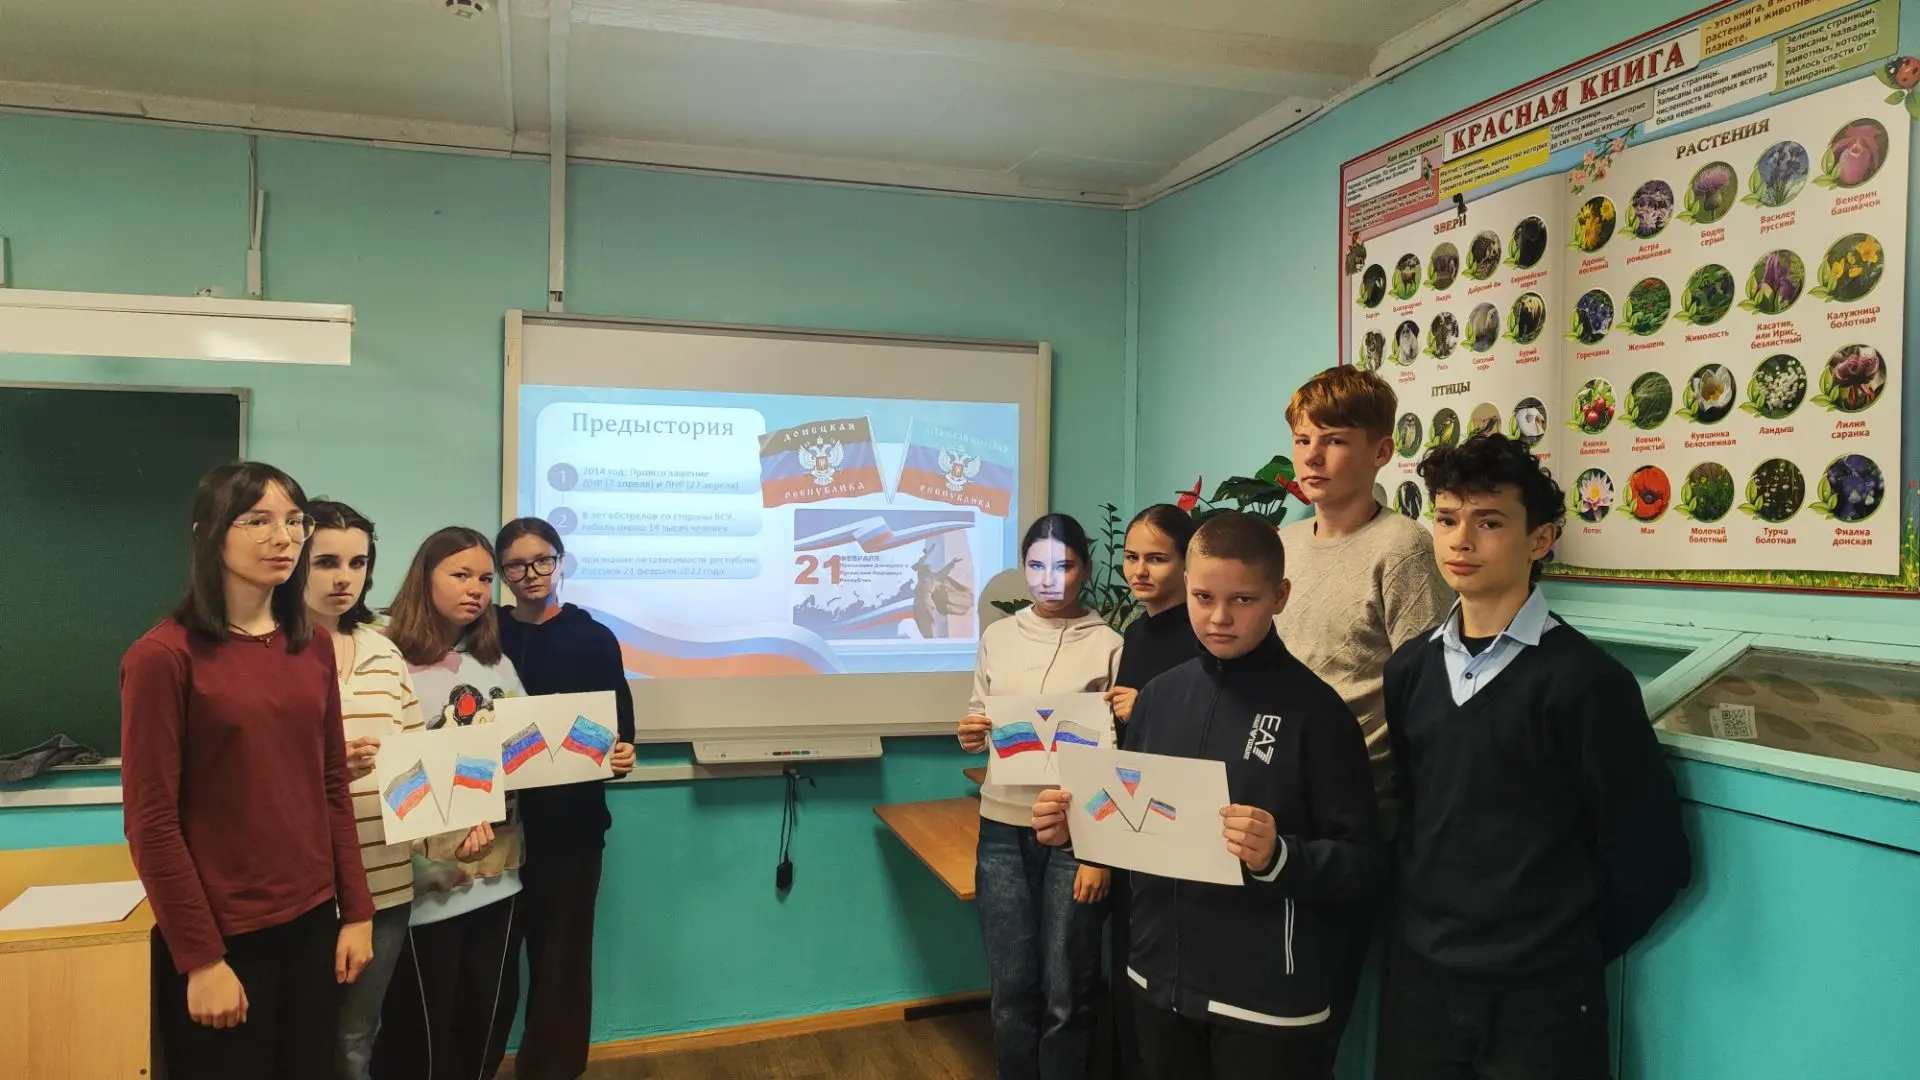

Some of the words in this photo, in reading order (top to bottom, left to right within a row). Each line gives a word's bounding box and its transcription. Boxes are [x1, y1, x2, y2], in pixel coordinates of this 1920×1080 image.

[1714, 17, 1731, 29] это
[1733, 4, 1764, 20] книга,
[1706, 18, 1751, 46] растений
[1786, 26, 1825, 44] Зеленые
[1827, 8, 1875, 29] страницы.
[1786, 35, 1828, 54] Записаны
[1831, 18, 1875, 38] названия
[1705, 34, 1748, 55] планете.
[1786, 45, 1832, 65] животных,
[1836, 29, 1877, 47] которых
[1784, 60, 1820, 77] удалось
[1823, 48, 1854, 64] спасти
[1856, 43, 1867, 52] от
[1657, 84, 1679, 96] Белые
[1682, 70, 1720, 87] страницы.
[1784, 64, 1838, 86] вымирания.
[1657, 89, 1692, 106] Записаны
[1693, 76, 1729, 93] названия
[1731, 61, 1774, 80] животных,
[1452, 87, 1568, 153] КРАСНАЯ
[1580, 42, 1685, 104] КНИГА
[1656, 97, 1702, 115] численность
[1704, 83, 1737, 99] которых
[1740, 73, 1767, 86] всегда
[1656, 114, 1674, 125] была
[1676, 118, 1770, 159] РАСТЕНИЯ
[1835, 190, 1878, 206] Венерин
[1760, 209, 1796, 224] Василек
[1433, 215, 1467, 235] ЗВЕРИ
[1760, 218, 1796, 235] русский
[1638, 243, 1660, 254] Астра
[1700, 235, 1725, 248] серый
[1826, 305, 1881, 321] Калужница
[1756, 320, 1794, 332] Касатик,
[1830, 315, 1877, 329] болотная
[1684, 330, 1729, 343] Жимолость
[1750, 335, 1802, 349] безлистный
[1755, 332, 1767, 340] или
[1769, 328, 1797, 339] Ирис,
[1431, 381, 1471, 397] ПТИЦЫ
[571, 412, 734, 440] Предыстория
[783, 422, 857, 443] ДОНЕЦКАЯ
[1759, 425, 1794, 435] Ландыш
[1835, 420, 1866, 429] Лилия
[1690, 430, 1730, 440] Кувшинка
[1831, 429, 1870, 440] саранка
[1684, 438, 1737, 449] белоснежная
[559, 470, 566, 483] 1
[785, 481, 866, 500] РЕСПУБЛИКА
[557, 515, 567, 527] 2
[1689, 534, 1728, 544] болотный
[1691, 526, 1726, 536] Молочай
[1763, 527, 1788, 537] Турча
[1834, 527, 1870, 537] Фиалка
[1755, 535, 1796, 545] болотная
[1833, 537, 1872, 546] донская
[794, 554, 841, 585] 21
[1253, 714, 1281, 765] EA7
